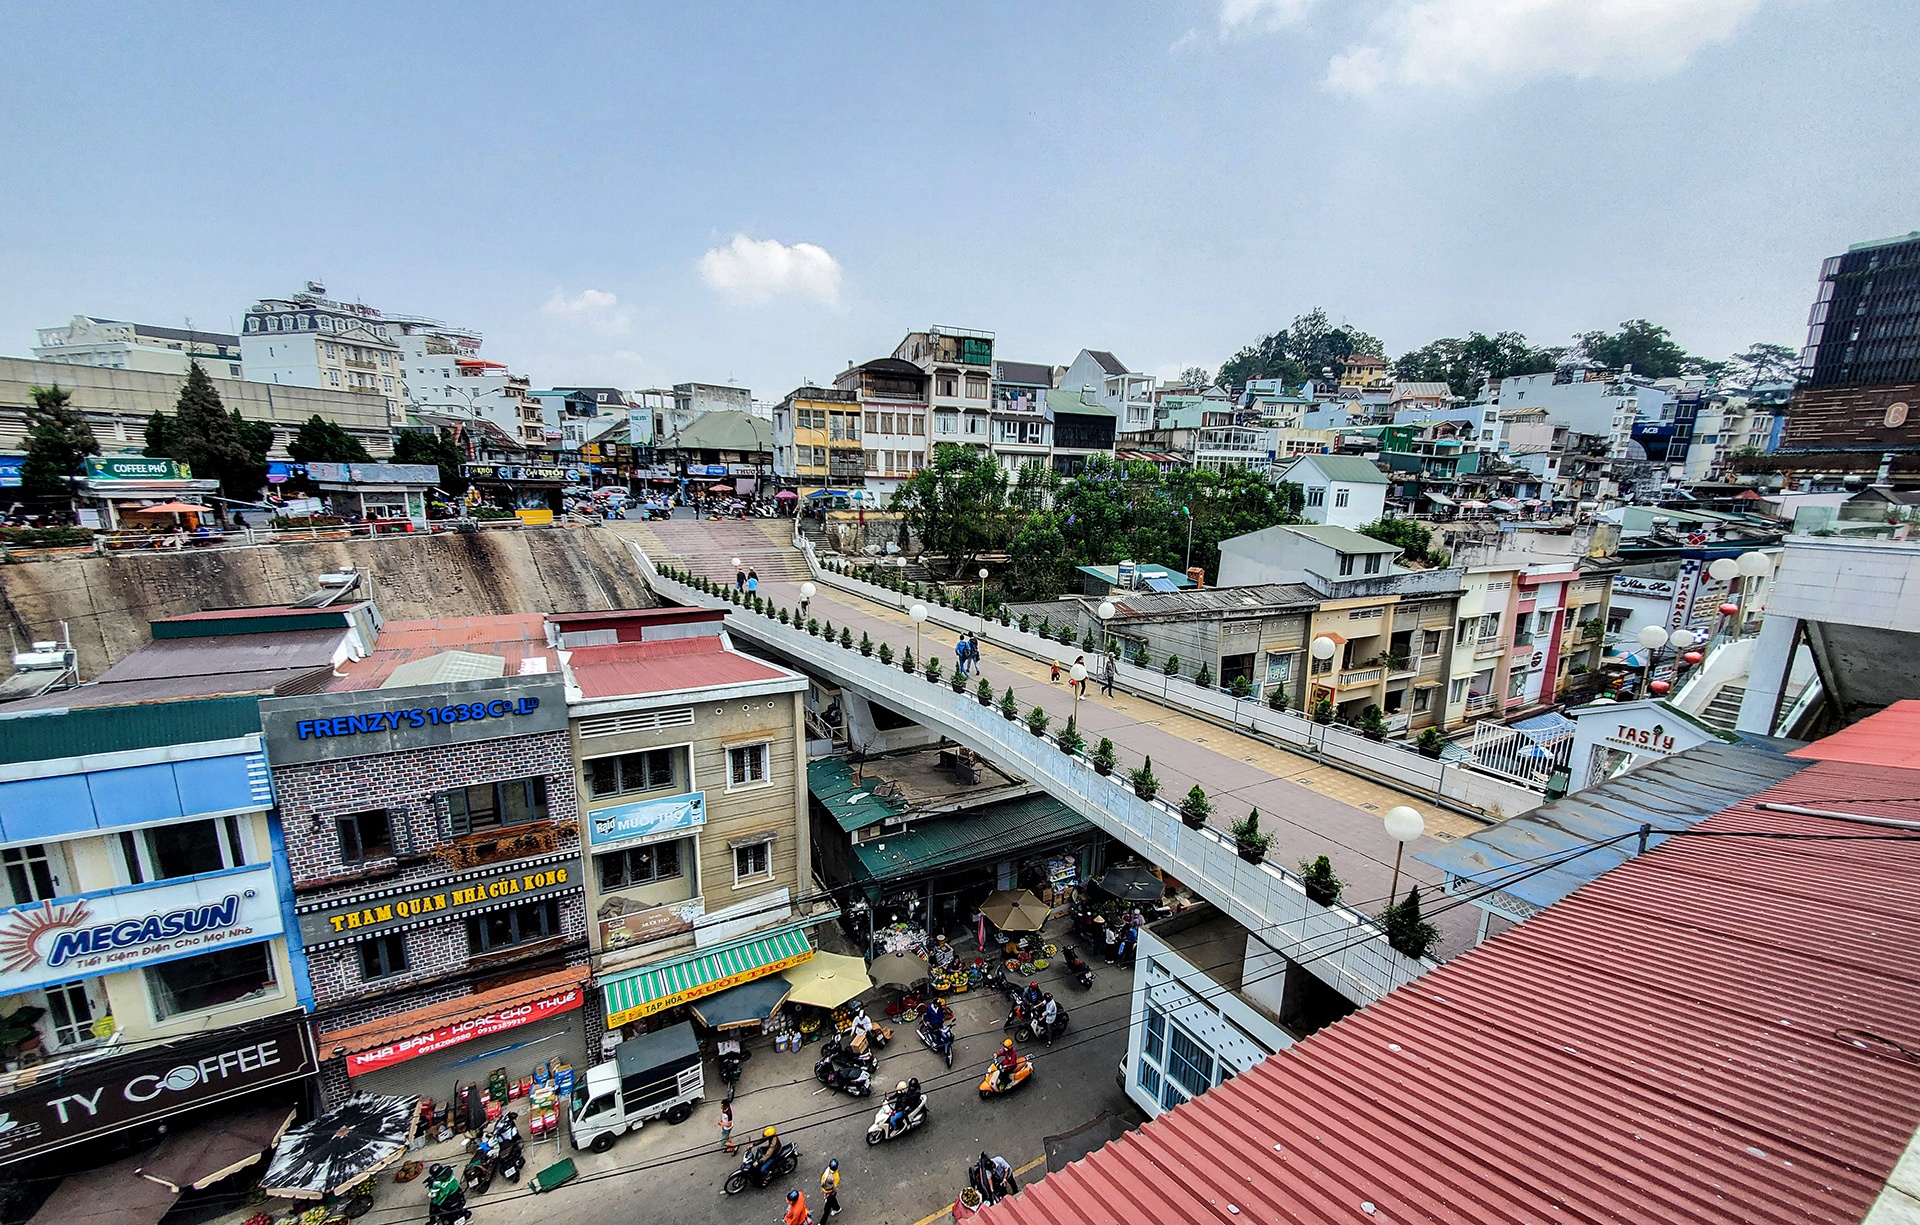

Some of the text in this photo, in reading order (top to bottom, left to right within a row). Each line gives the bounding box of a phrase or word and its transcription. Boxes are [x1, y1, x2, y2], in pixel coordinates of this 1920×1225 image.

[113, 463, 148, 473] COFFEE
[1671, 576, 1690, 630] PHARMACY
[297, 708, 424, 740] FRENZY'S
[428, 702, 486, 726] 1638
[596, 818, 616, 834] Raid
[329, 868, 568, 934] THAM QUAN NHÀ CỦA KONG
[47, 894, 239, 967] MEGASUN
[174, 937, 200, 949] Cho
[229, 926, 253, 938] Nhà
[500, 1004, 533, 1021] CHO
[46, 1039, 282, 1124] TY COFFEE
